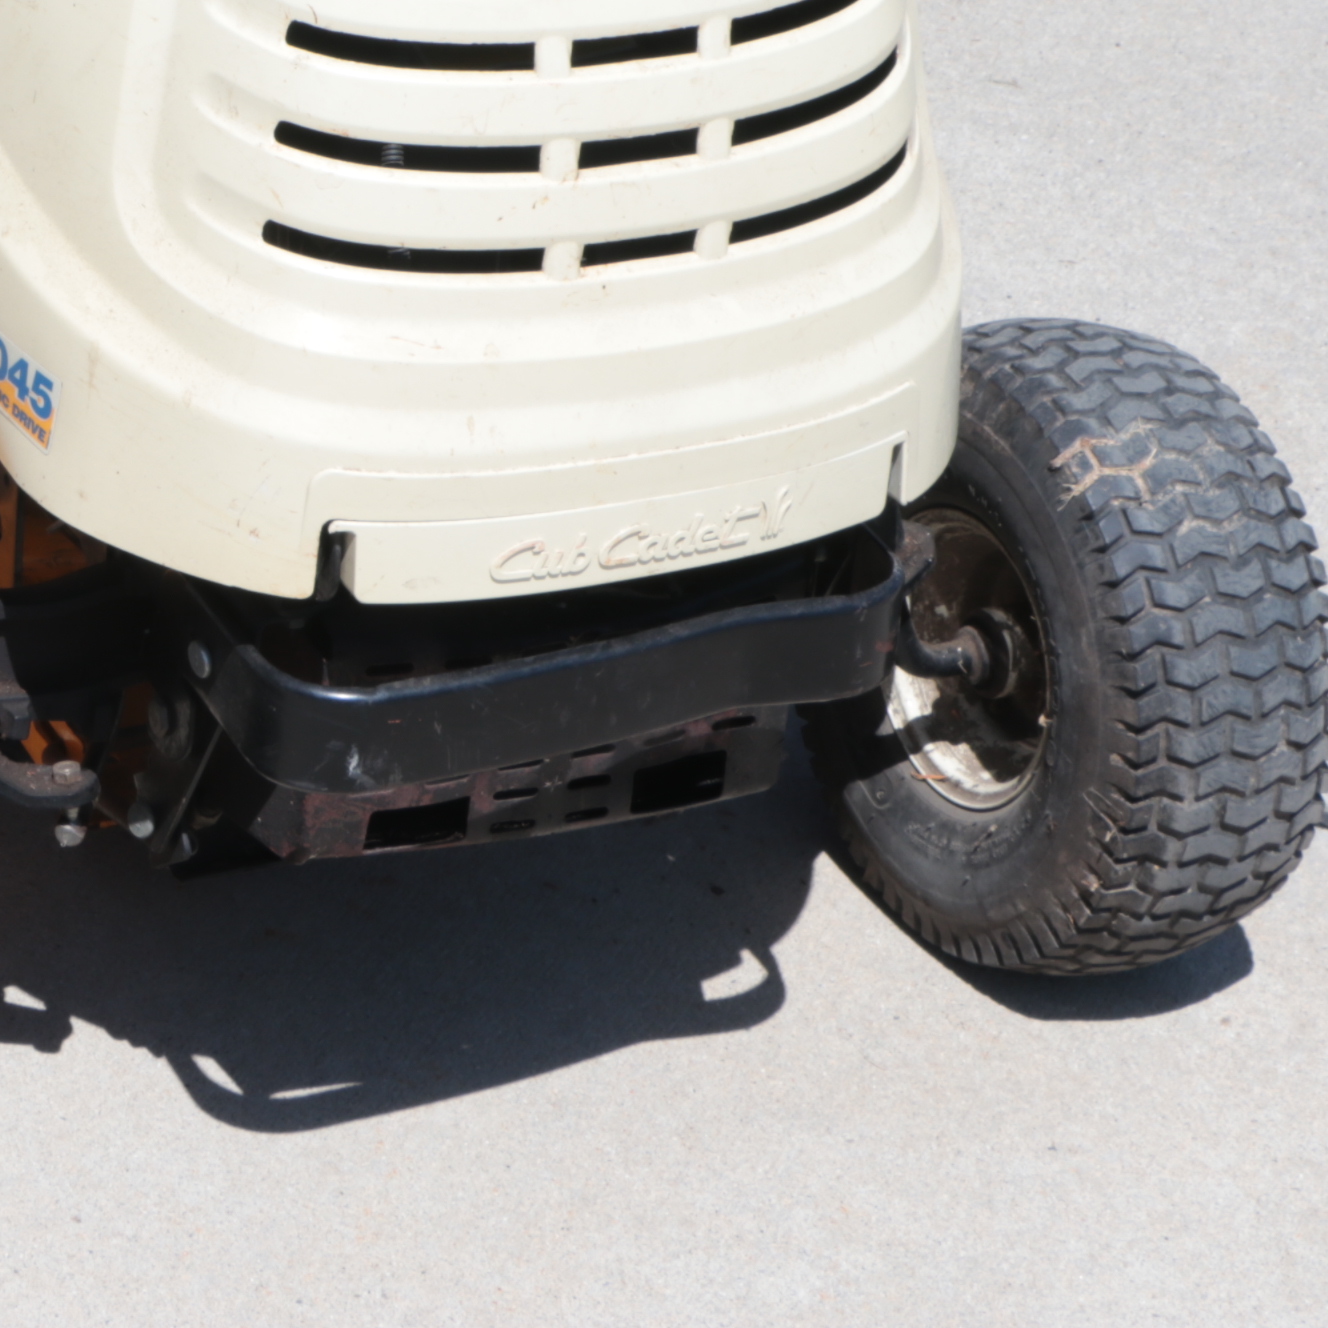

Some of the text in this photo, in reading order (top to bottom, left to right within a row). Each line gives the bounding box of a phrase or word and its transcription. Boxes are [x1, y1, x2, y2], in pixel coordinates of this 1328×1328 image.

[12, 402, 47, 443] DRIVE
[489, 504, 761, 584] Cub Cadet
